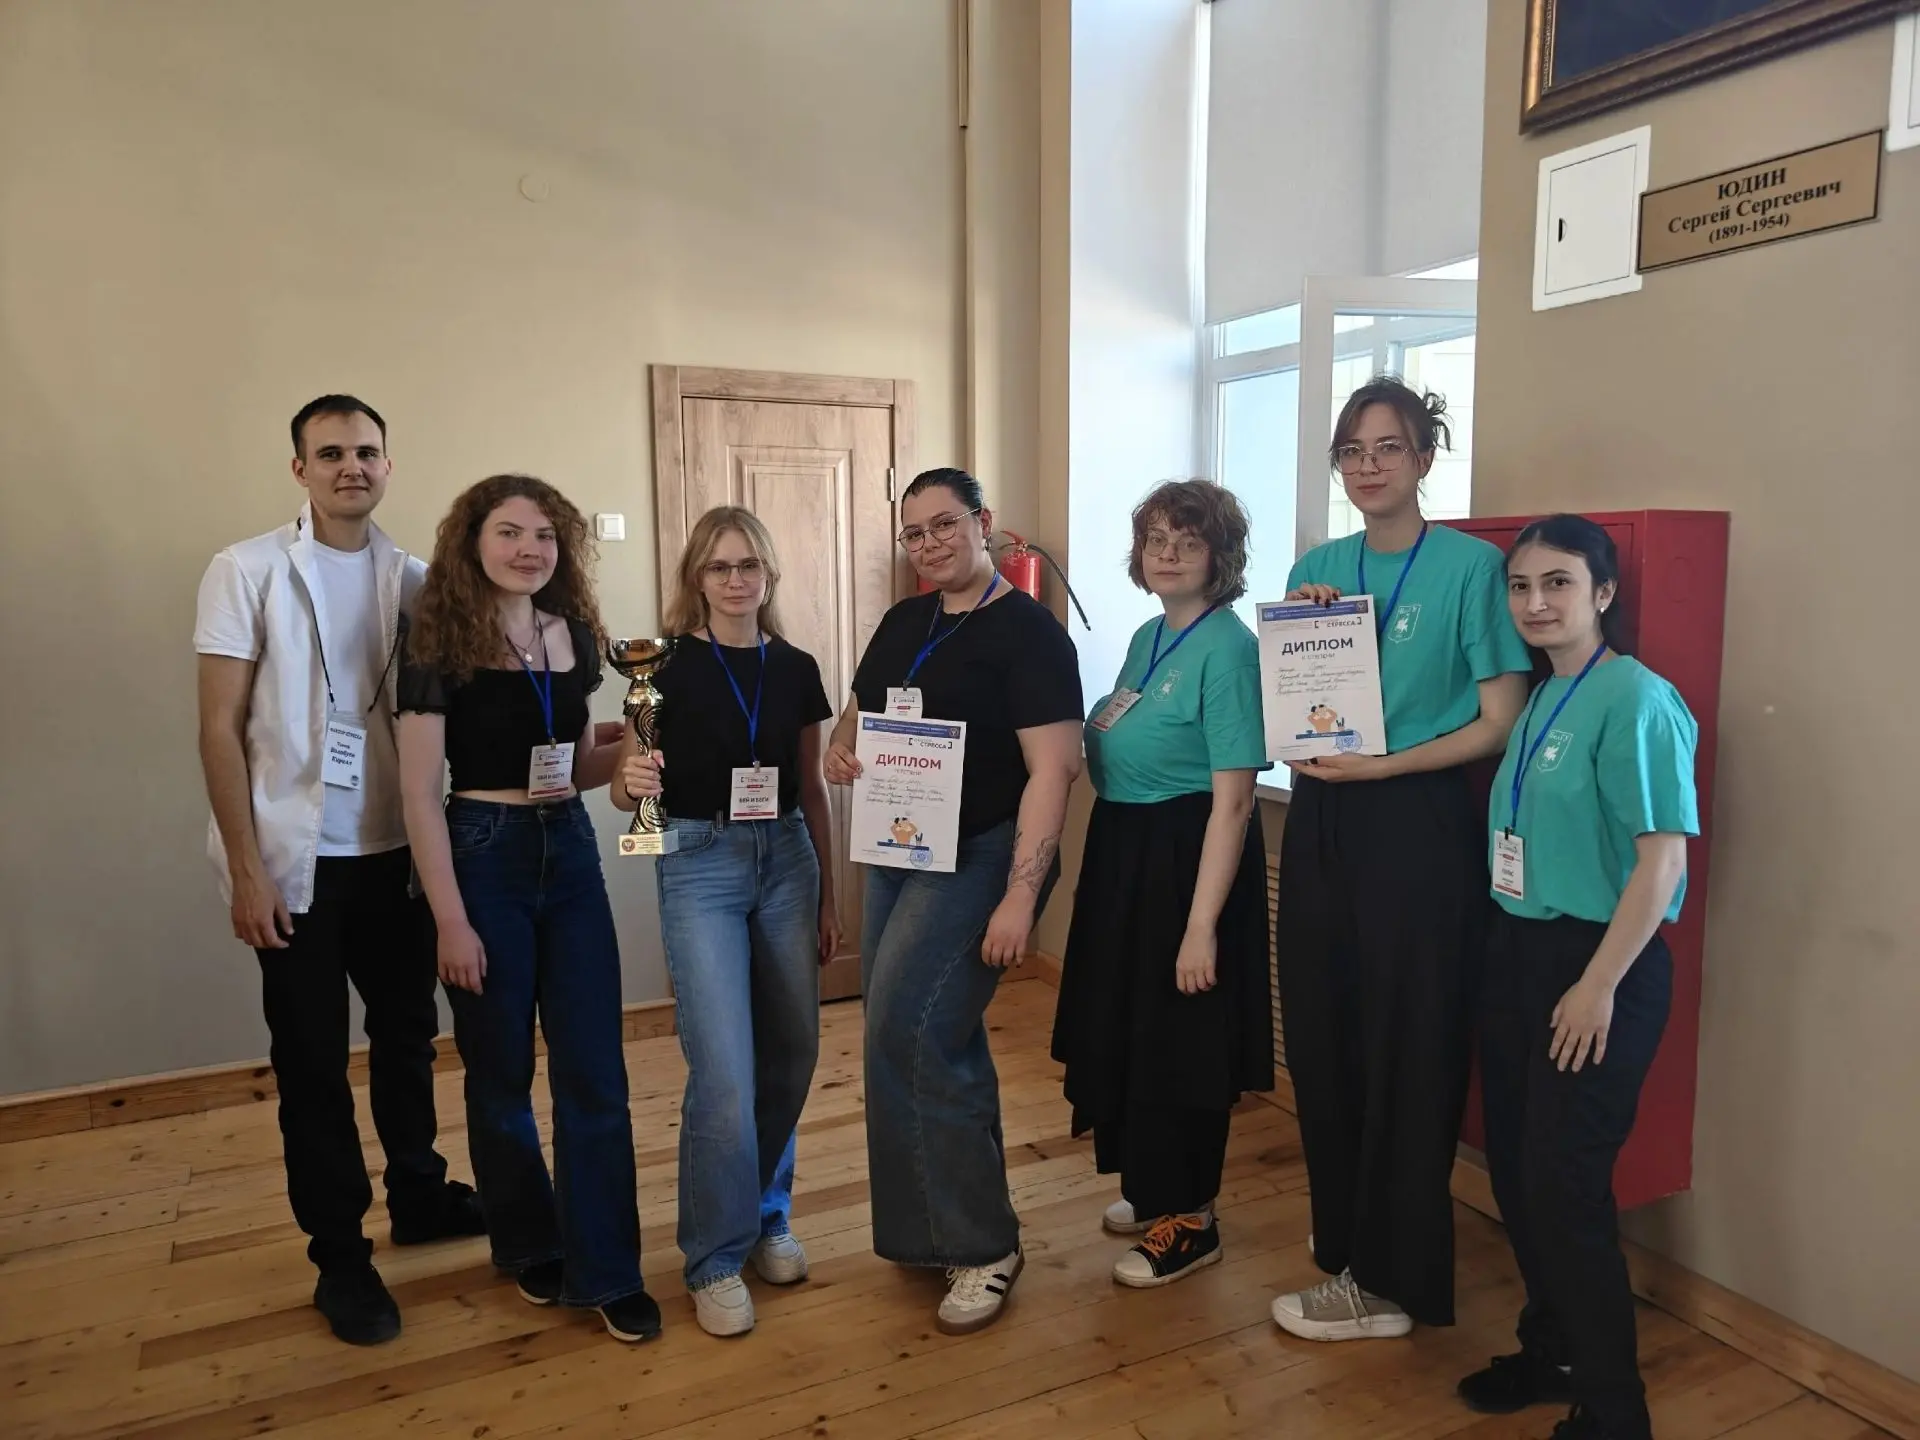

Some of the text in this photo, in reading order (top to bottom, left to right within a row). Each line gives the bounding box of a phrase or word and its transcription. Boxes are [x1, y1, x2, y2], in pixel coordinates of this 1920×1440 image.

[1717, 167, 1787, 200] ЮДИН
[1668, 180, 1842, 234] Сергей Сергеевич
[1708, 212, 1791, 244] (1891-1954)
[1281, 637, 1353, 656] ДИПЛОМ
[875, 753, 942, 770] ДИПЛОМ
